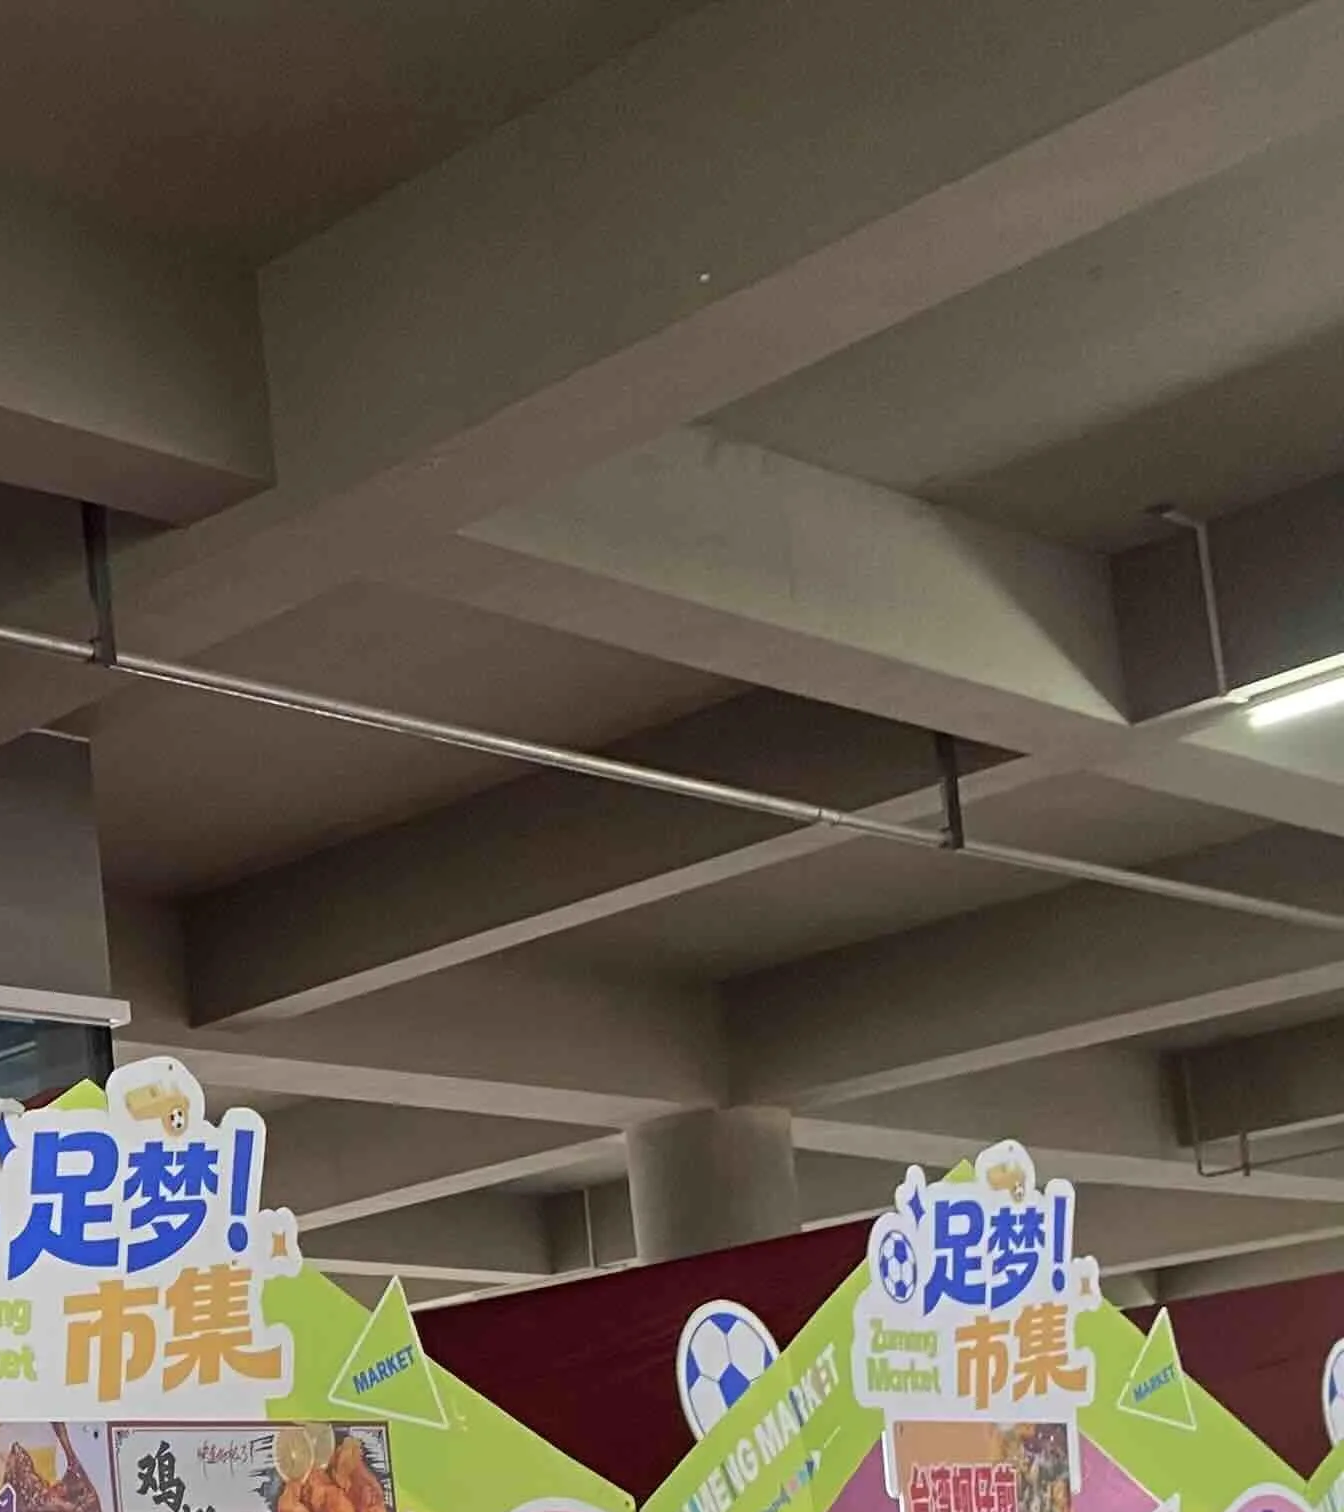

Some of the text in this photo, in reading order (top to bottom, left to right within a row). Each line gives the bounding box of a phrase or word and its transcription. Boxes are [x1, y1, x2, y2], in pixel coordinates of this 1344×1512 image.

[7, 1130, 256, 1280] 足梦!
[923, 1197, 1067, 1315] 足梦!
[63, 1268, 283, 1401] 市集
[353, 1345, 415, 1396] MARKET
[867, 1357, 941, 1395] Market
[954, 1303, 1088, 1410] 市集
[1132, 1364, 1175, 1404] MARKET
[754, 1342, 839, 1465] MARKET
